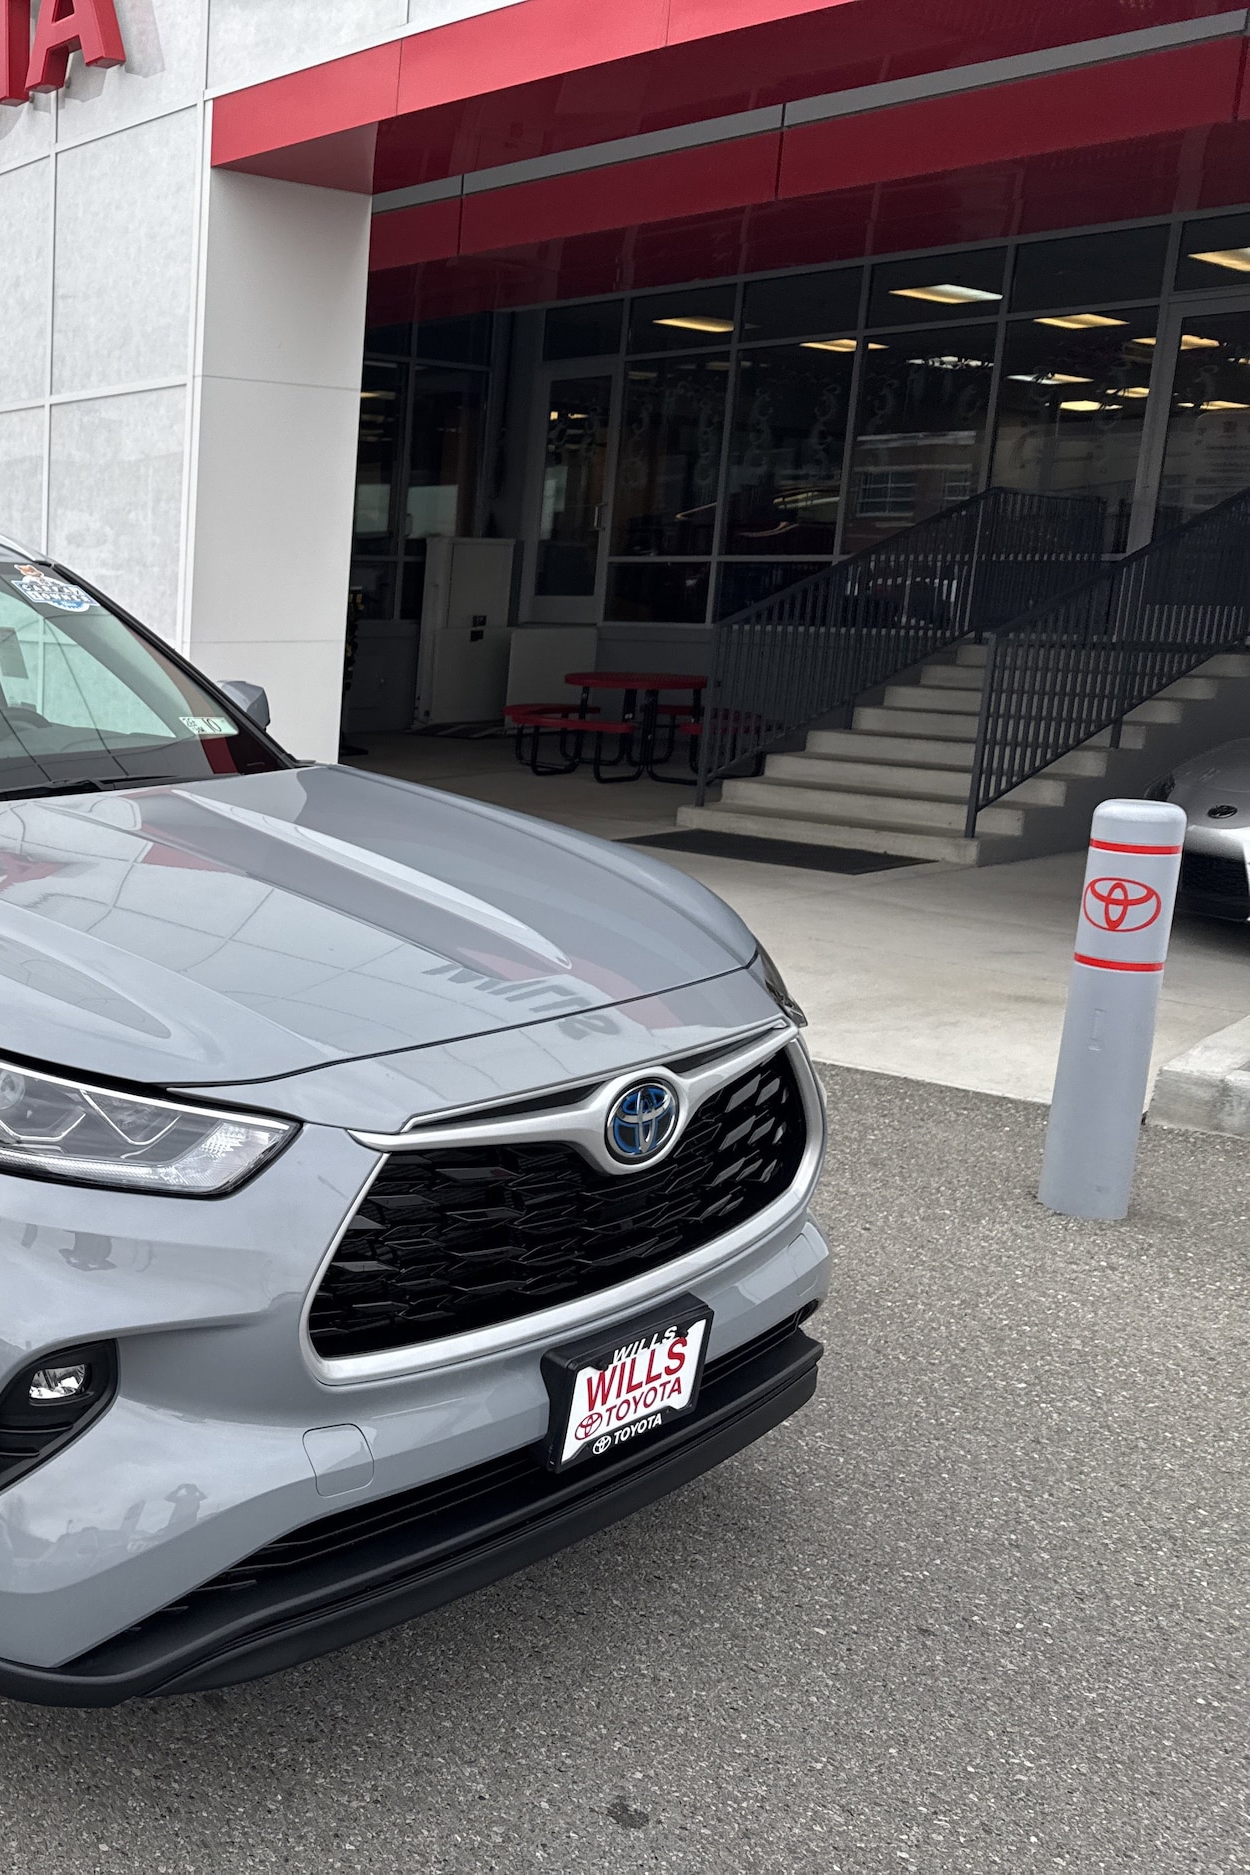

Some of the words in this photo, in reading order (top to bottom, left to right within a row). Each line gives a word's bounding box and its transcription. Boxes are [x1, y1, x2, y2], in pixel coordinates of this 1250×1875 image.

[612, 1326, 678, 1363] WILLS
[586, 1337, 688, 1412] WILLS
[606, 1377, 682, 1427] TOYOTA
[614, 1413, 662, 1445] TOYOTA
